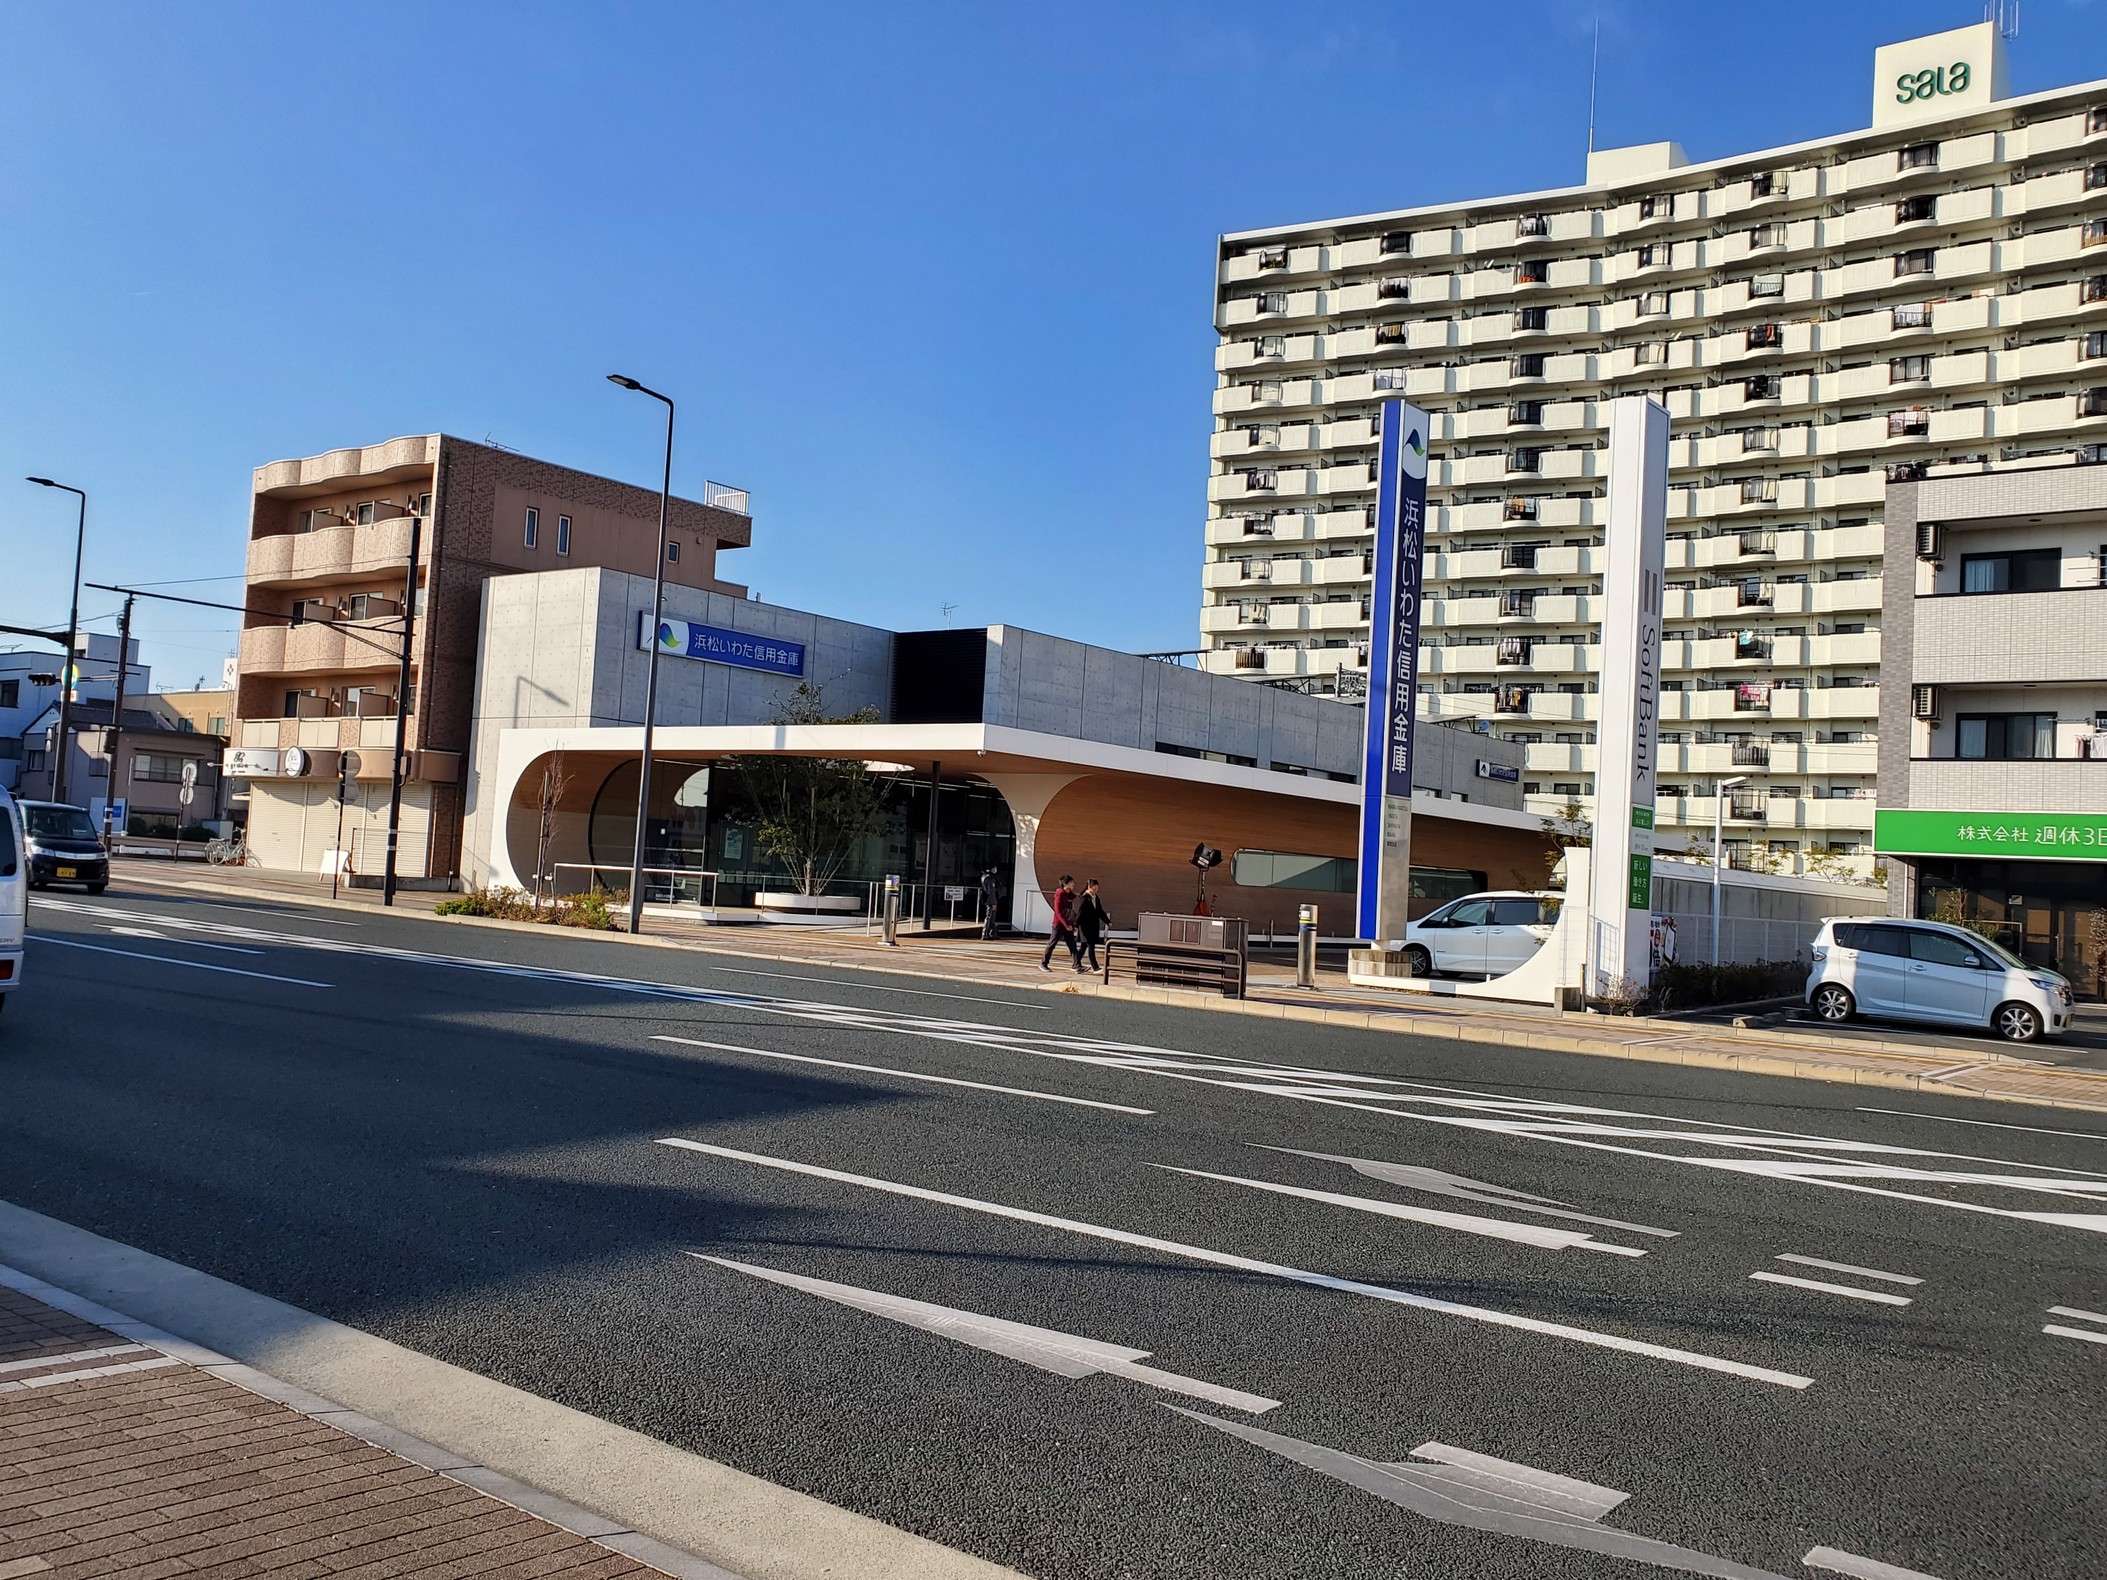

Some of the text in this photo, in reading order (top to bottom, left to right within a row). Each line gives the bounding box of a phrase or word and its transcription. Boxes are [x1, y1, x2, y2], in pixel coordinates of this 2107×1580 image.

[1896, 62, 1971, 104] sala
[693, 633, 799, 667] 浜松いわた信用金庫
[1391, 497, 1419, 774] 浜松いわた信用金庫
[1636, 624, 1656, 782] SoftBank
[1957, 825, 2029, 842] 株式会社
